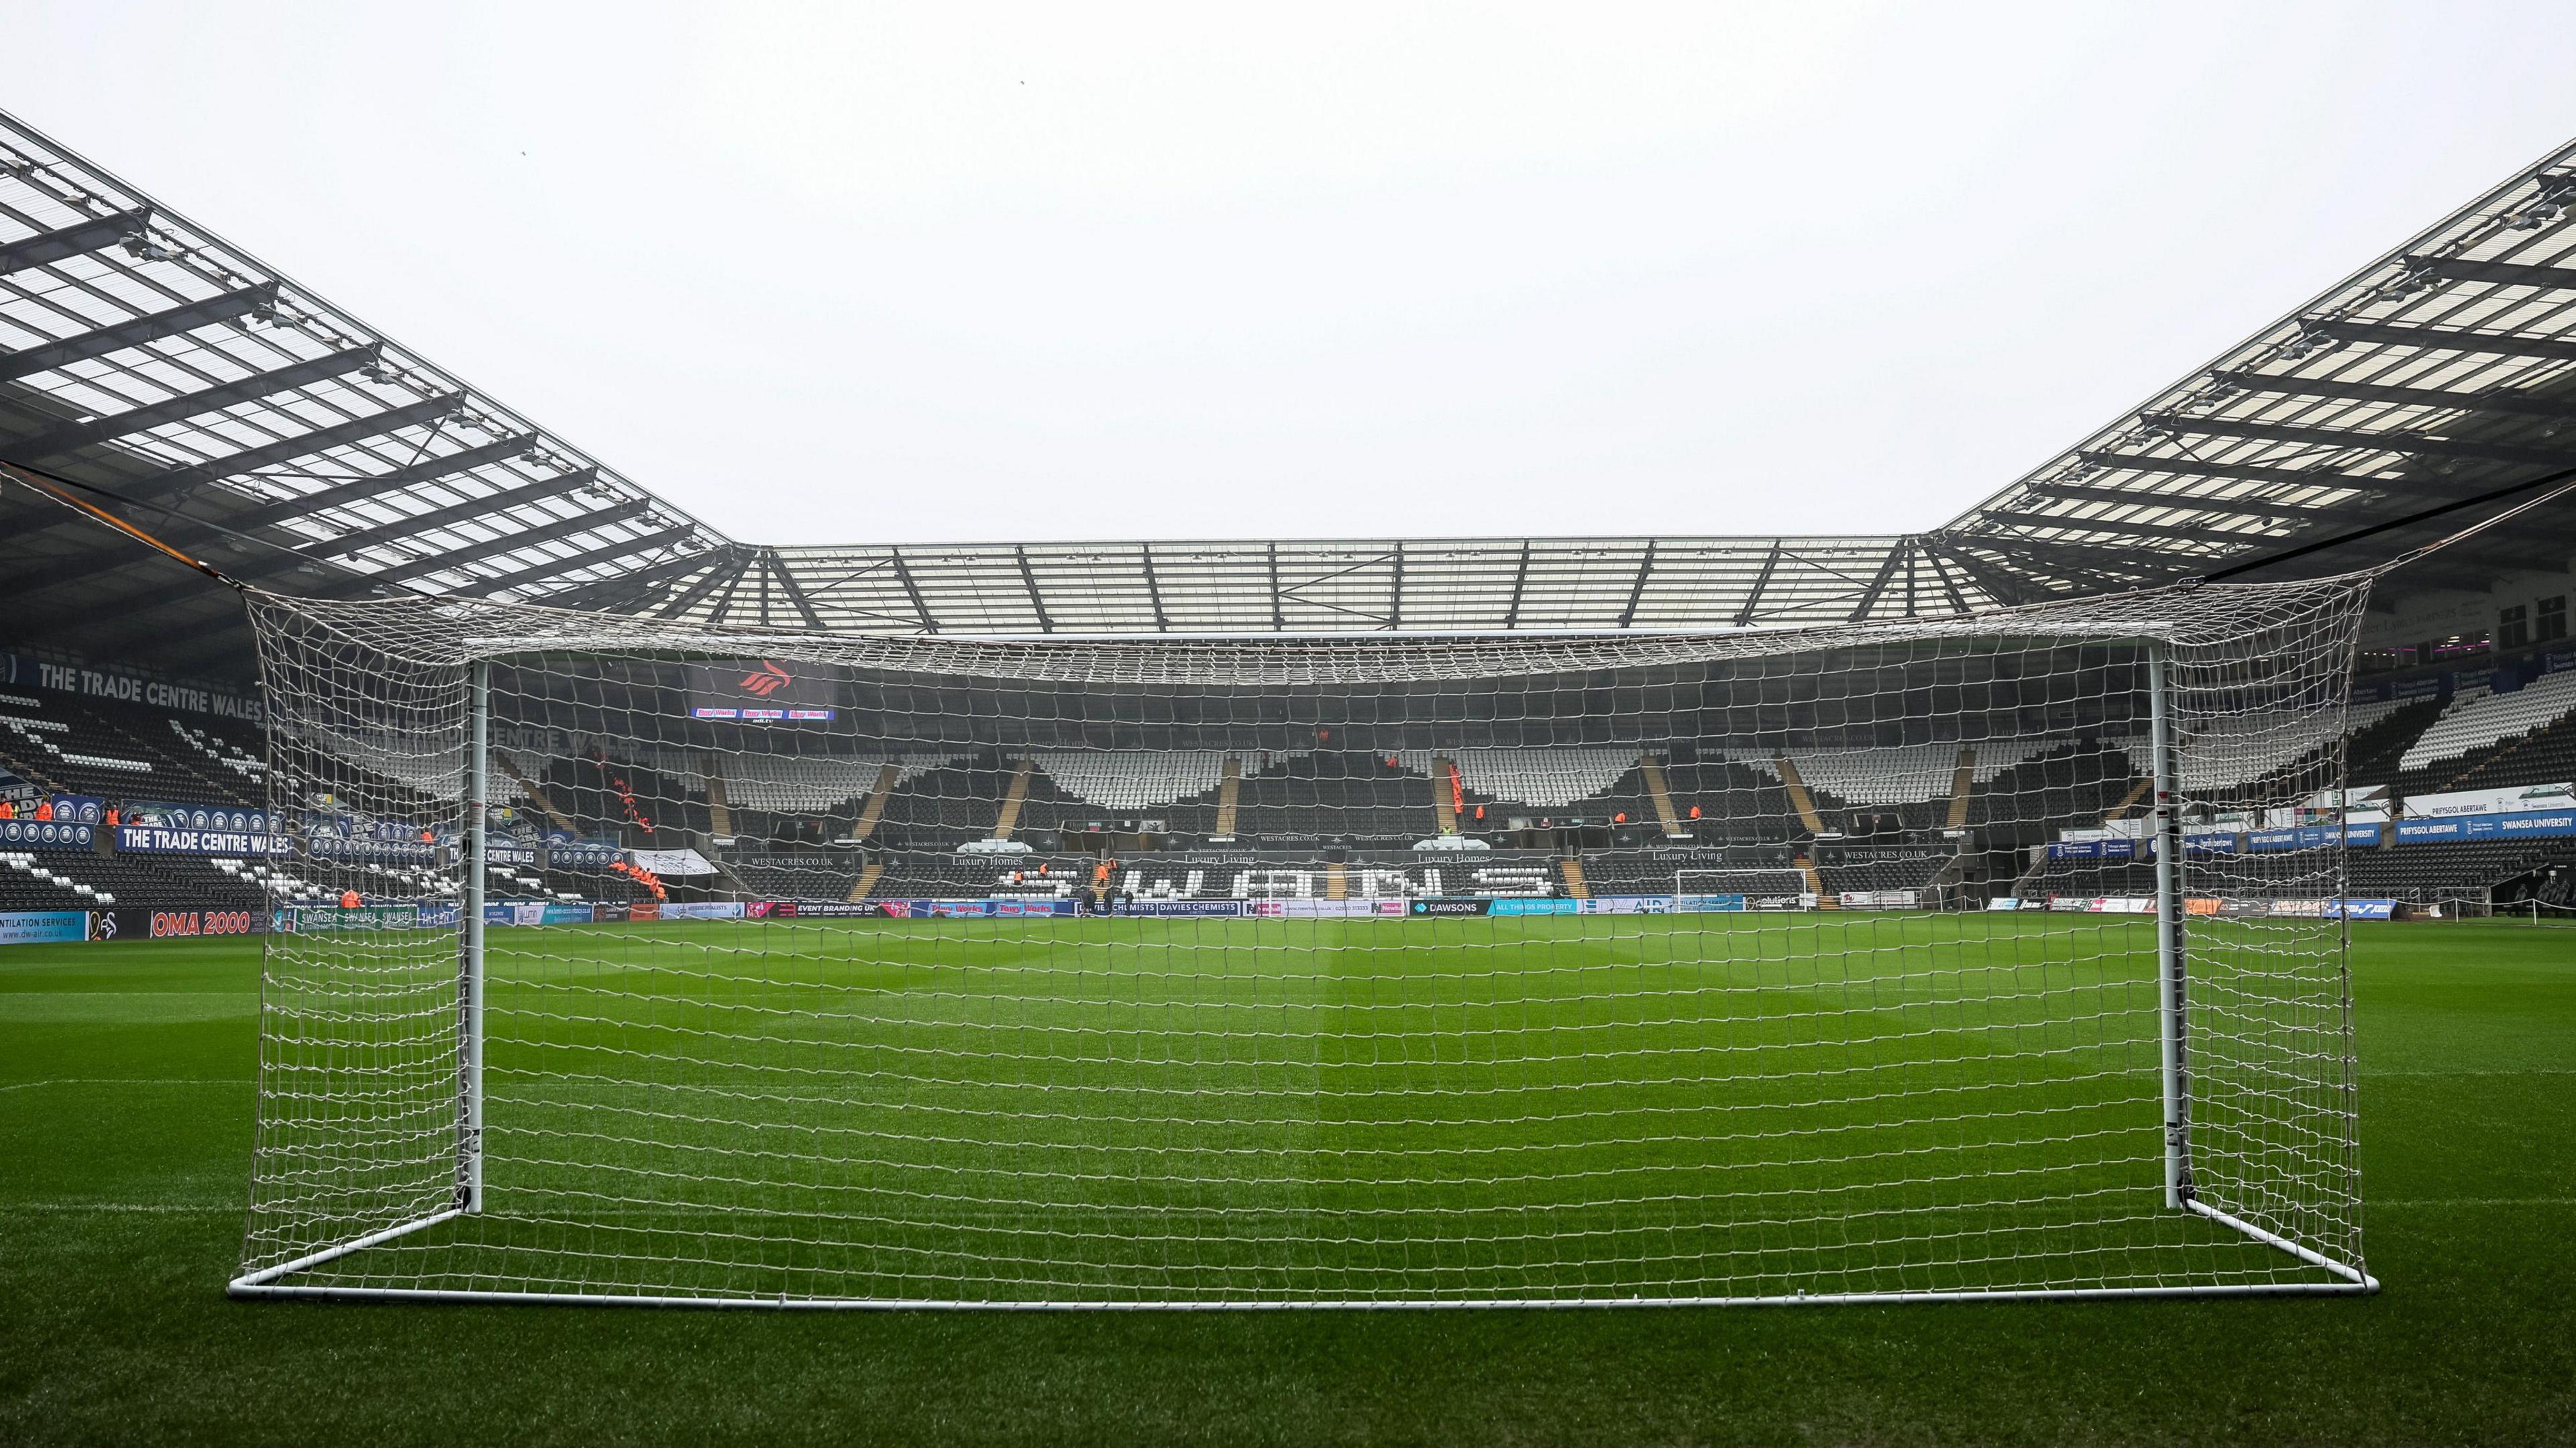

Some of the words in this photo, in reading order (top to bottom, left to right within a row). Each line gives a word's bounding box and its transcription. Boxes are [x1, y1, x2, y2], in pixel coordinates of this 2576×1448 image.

[40, 663, 75, 691] THE
[81, 671, 141, 702] TRADE
[146, 682, 208, 712] CENTRE
[212, 693, 262, 722] WALES
[2432, 805, 2459, 815] PRIFYSGOL
[2460, 804, 2487, 814] ABERTAWE
[2502, 820, 2533, 830] SWANSEA
[2534, 818, 2572, 829] UNIVERSITY
[2347, 830, 2375, 838] UNIVERSITY
[2400, 826, 2428, 836] PRIFYSGOL
[2429, 824, 2457, 834] ABERTAWE
[124, 829, 150, 848] THE
[154, 830, 198, 850] TRADE
[201, 832, 248, 852] CENTRE
[251, 835, 288, 854] WALES
[487, 849, 511, 862] CENTRE
[512, 850, 534, 863] WALES
[1185, 854, 1220, 865] Luxury
[1223, 854, 1254, 865] Living
[1418, 854, 1452, 864] Luxury
[1456, 854, 1490, 862] Homes
[1653, 852, 1687, 862] Luxury
[1691, 851, 1722, 862] Living
[1845, 850, 1927, 859] WESTACRES.CO.UK
[751, 858, 833, 866] WESTACRES.CO.UK
[952, 857, 986, 868] Luxury
[990, 856, 1023, 866] Homes
[1000, 905, 1021, 913] Towy
[1430, 903, 1477, 912] DAWSONS
[42, 917, 76, 927] SERVICES
[301, 913, 337, 924] SWANSEA
[345, 913, 376, 922] SWANSEA
[382, 911, 412, 922] SWANSEA
[152, 911, 199, 937] OMA
[203, 911, 250, 934] 2000
[3, 930, 62, 939] www.dw-air.co.uk
